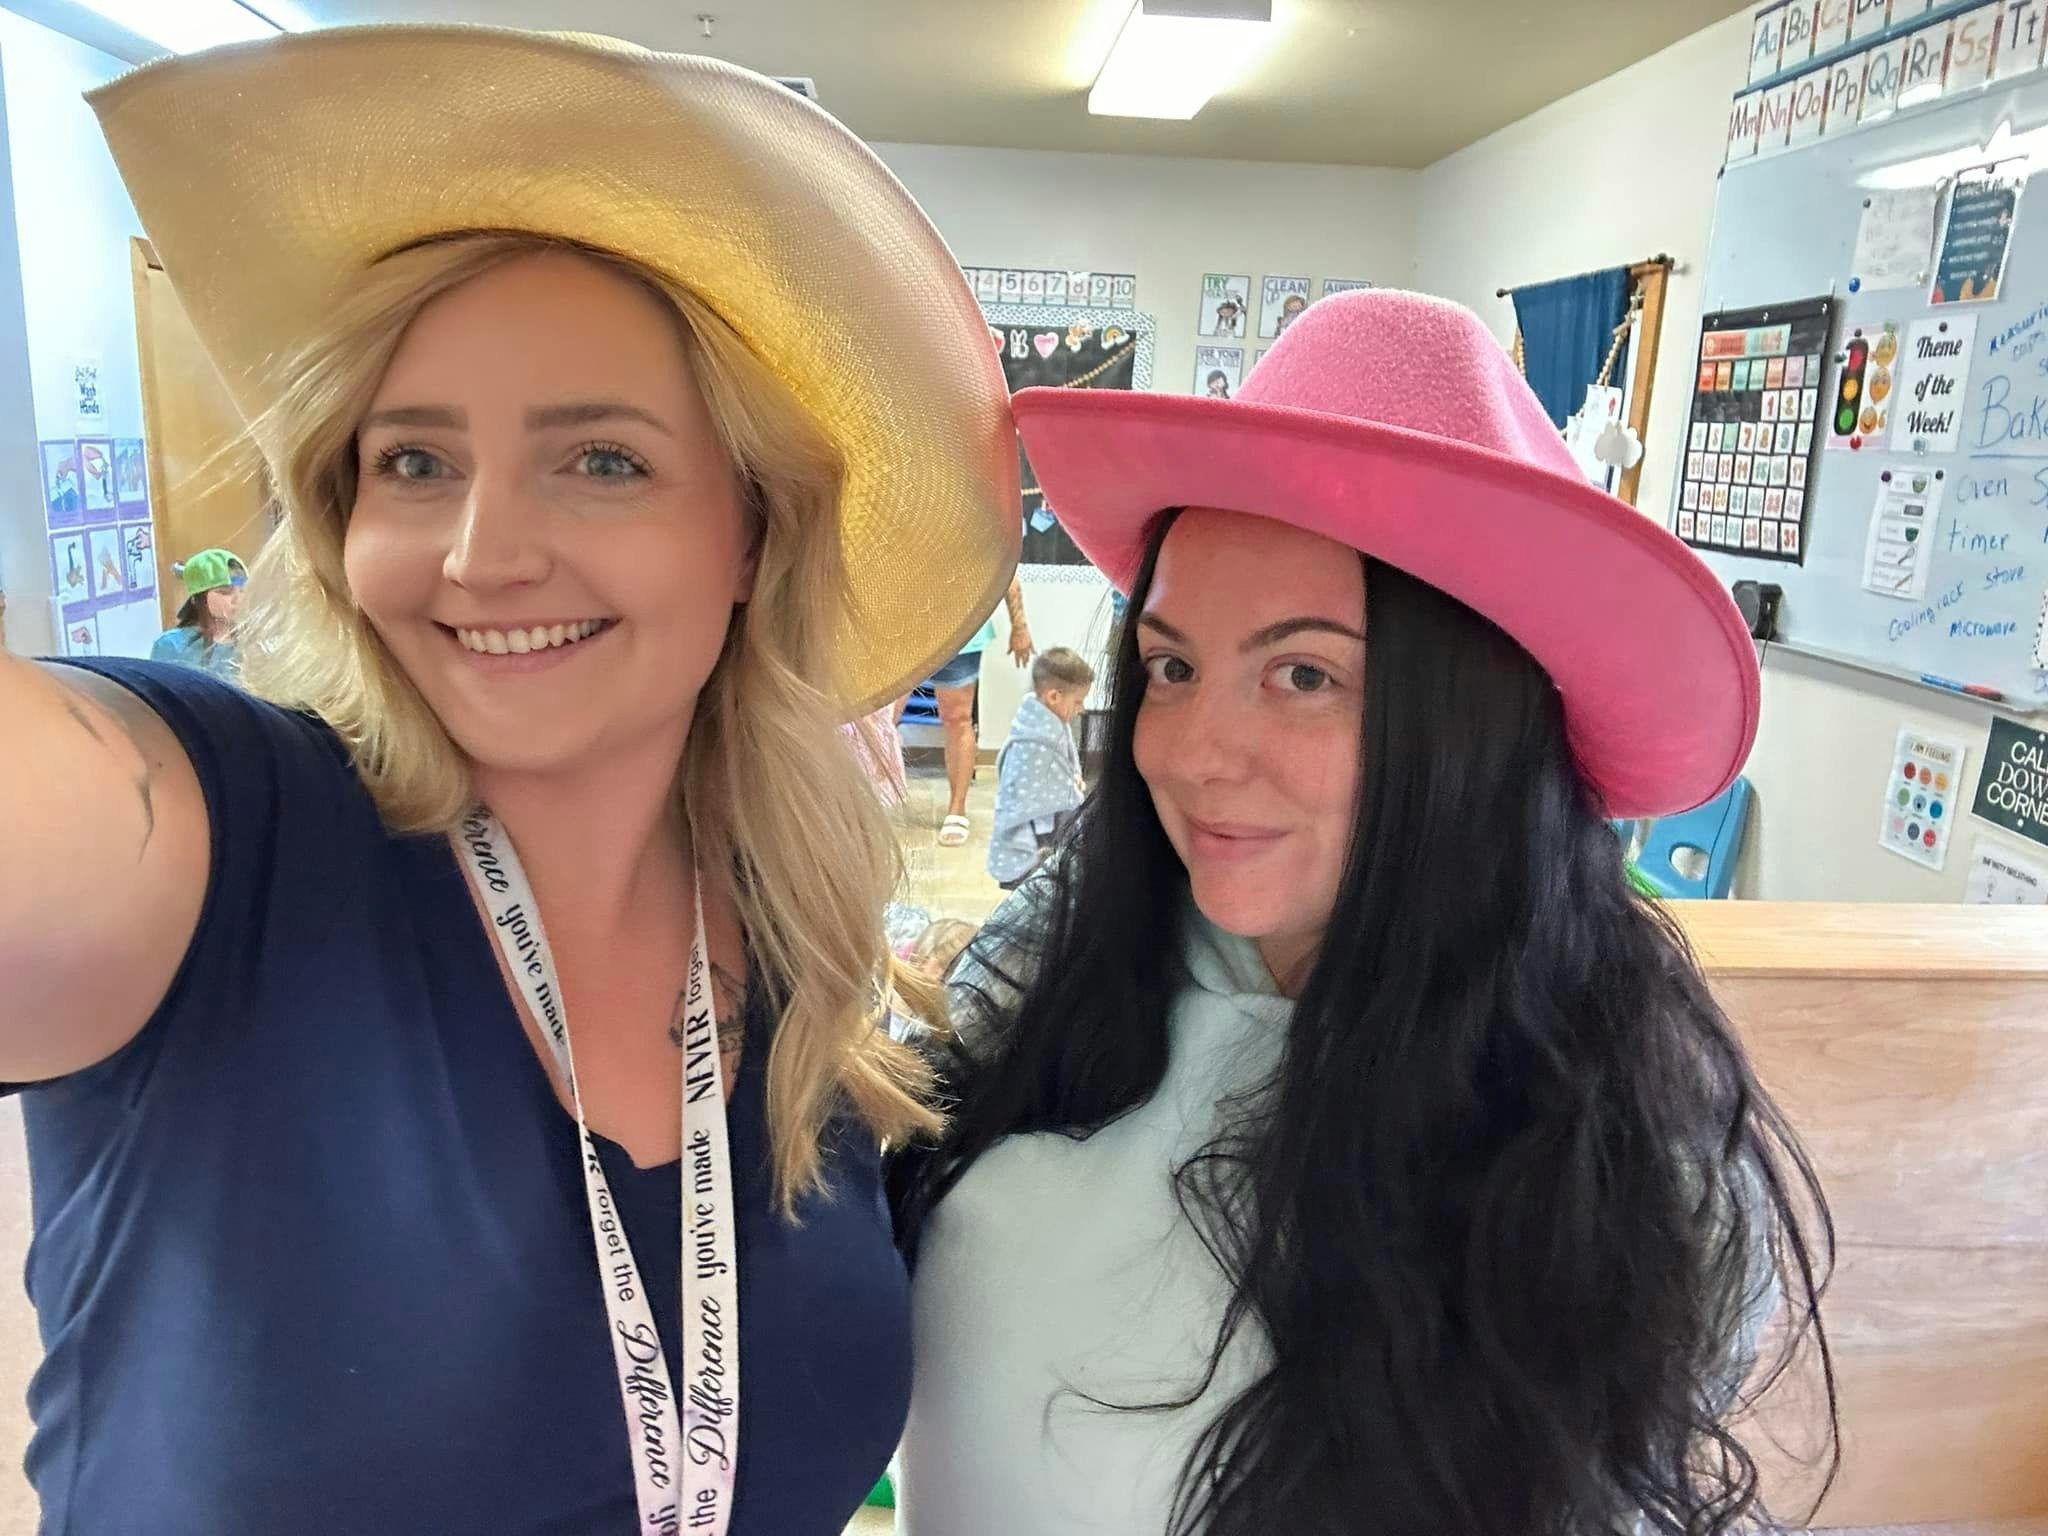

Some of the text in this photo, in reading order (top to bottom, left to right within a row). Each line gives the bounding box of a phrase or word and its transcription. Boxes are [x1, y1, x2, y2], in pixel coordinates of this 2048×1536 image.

[1754, 20, 1778, 61] Aa
[1786, 6, 1811, 46] Bb
[1762, 93, 1787, 135] Nn
[1795, 80, 1821, 120] Oo
[1831, 68, 1858, 115] Pp
[1868, 51, 1900, 100] Qq
[1908, 37, 1941, 84] Rr
[1953, 19, 1991, 67] Ss
[2008, 0, 2039, 50] Tt
[983, 273, 1132, 296] 4 5 6 7 8 9 10
[1206, 277, 1229, 289] TRY
[1265, 279, 1308, 294] CLEAN
[1265, 291, 1281, 305] UP
[1916, 335, 1963, 359] Theme
[1766, 395, 1775, 417] 1
[1914, 373, 1955, 402] of the
[1907, 410, 1955, 434] Week!
[1948, 518, 2009, 555] timer
[2011, 740, 2048, 774] CAL
[1997, 761, 2048, 800] DOW
[1986, 781, 2048, 825] CORNE
[496, 903, 543, 977] you've
[686, 1008, 717, 1105] NEVER
[687, 1128, 713, 1194] made
[688, 1202, 728, 1280] you've
[613, 1263, 635, 1302] the
[687, 1295, 734, 1472] Difference
[616, 1319, 672, 1490] Difference
[689, 1488, 717, 1528] the
